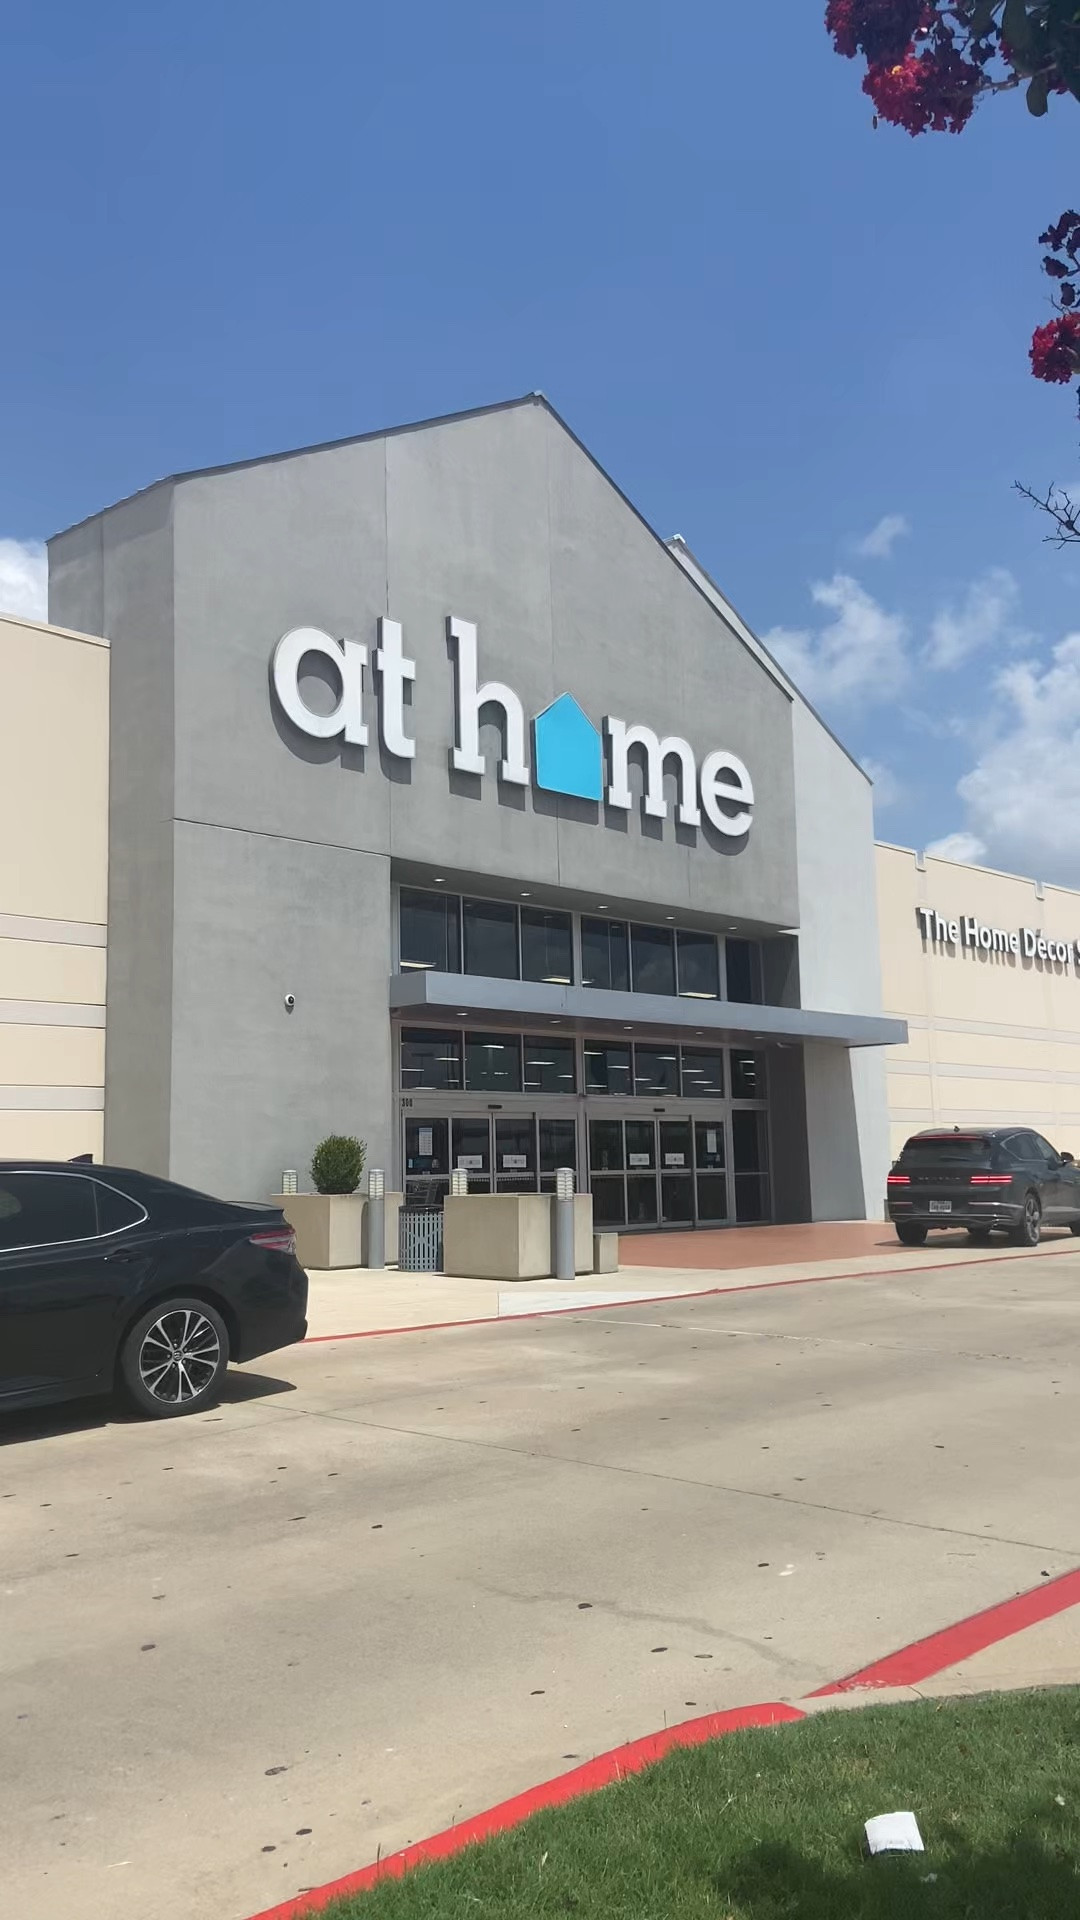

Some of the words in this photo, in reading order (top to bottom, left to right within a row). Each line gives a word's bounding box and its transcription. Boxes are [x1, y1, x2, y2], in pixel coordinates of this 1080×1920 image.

[271, 616, 416, 758] at
[448, 615, 755, 837] hme
[917, 907, 960, 944] The
[962, 915, 1020, 953] Home
